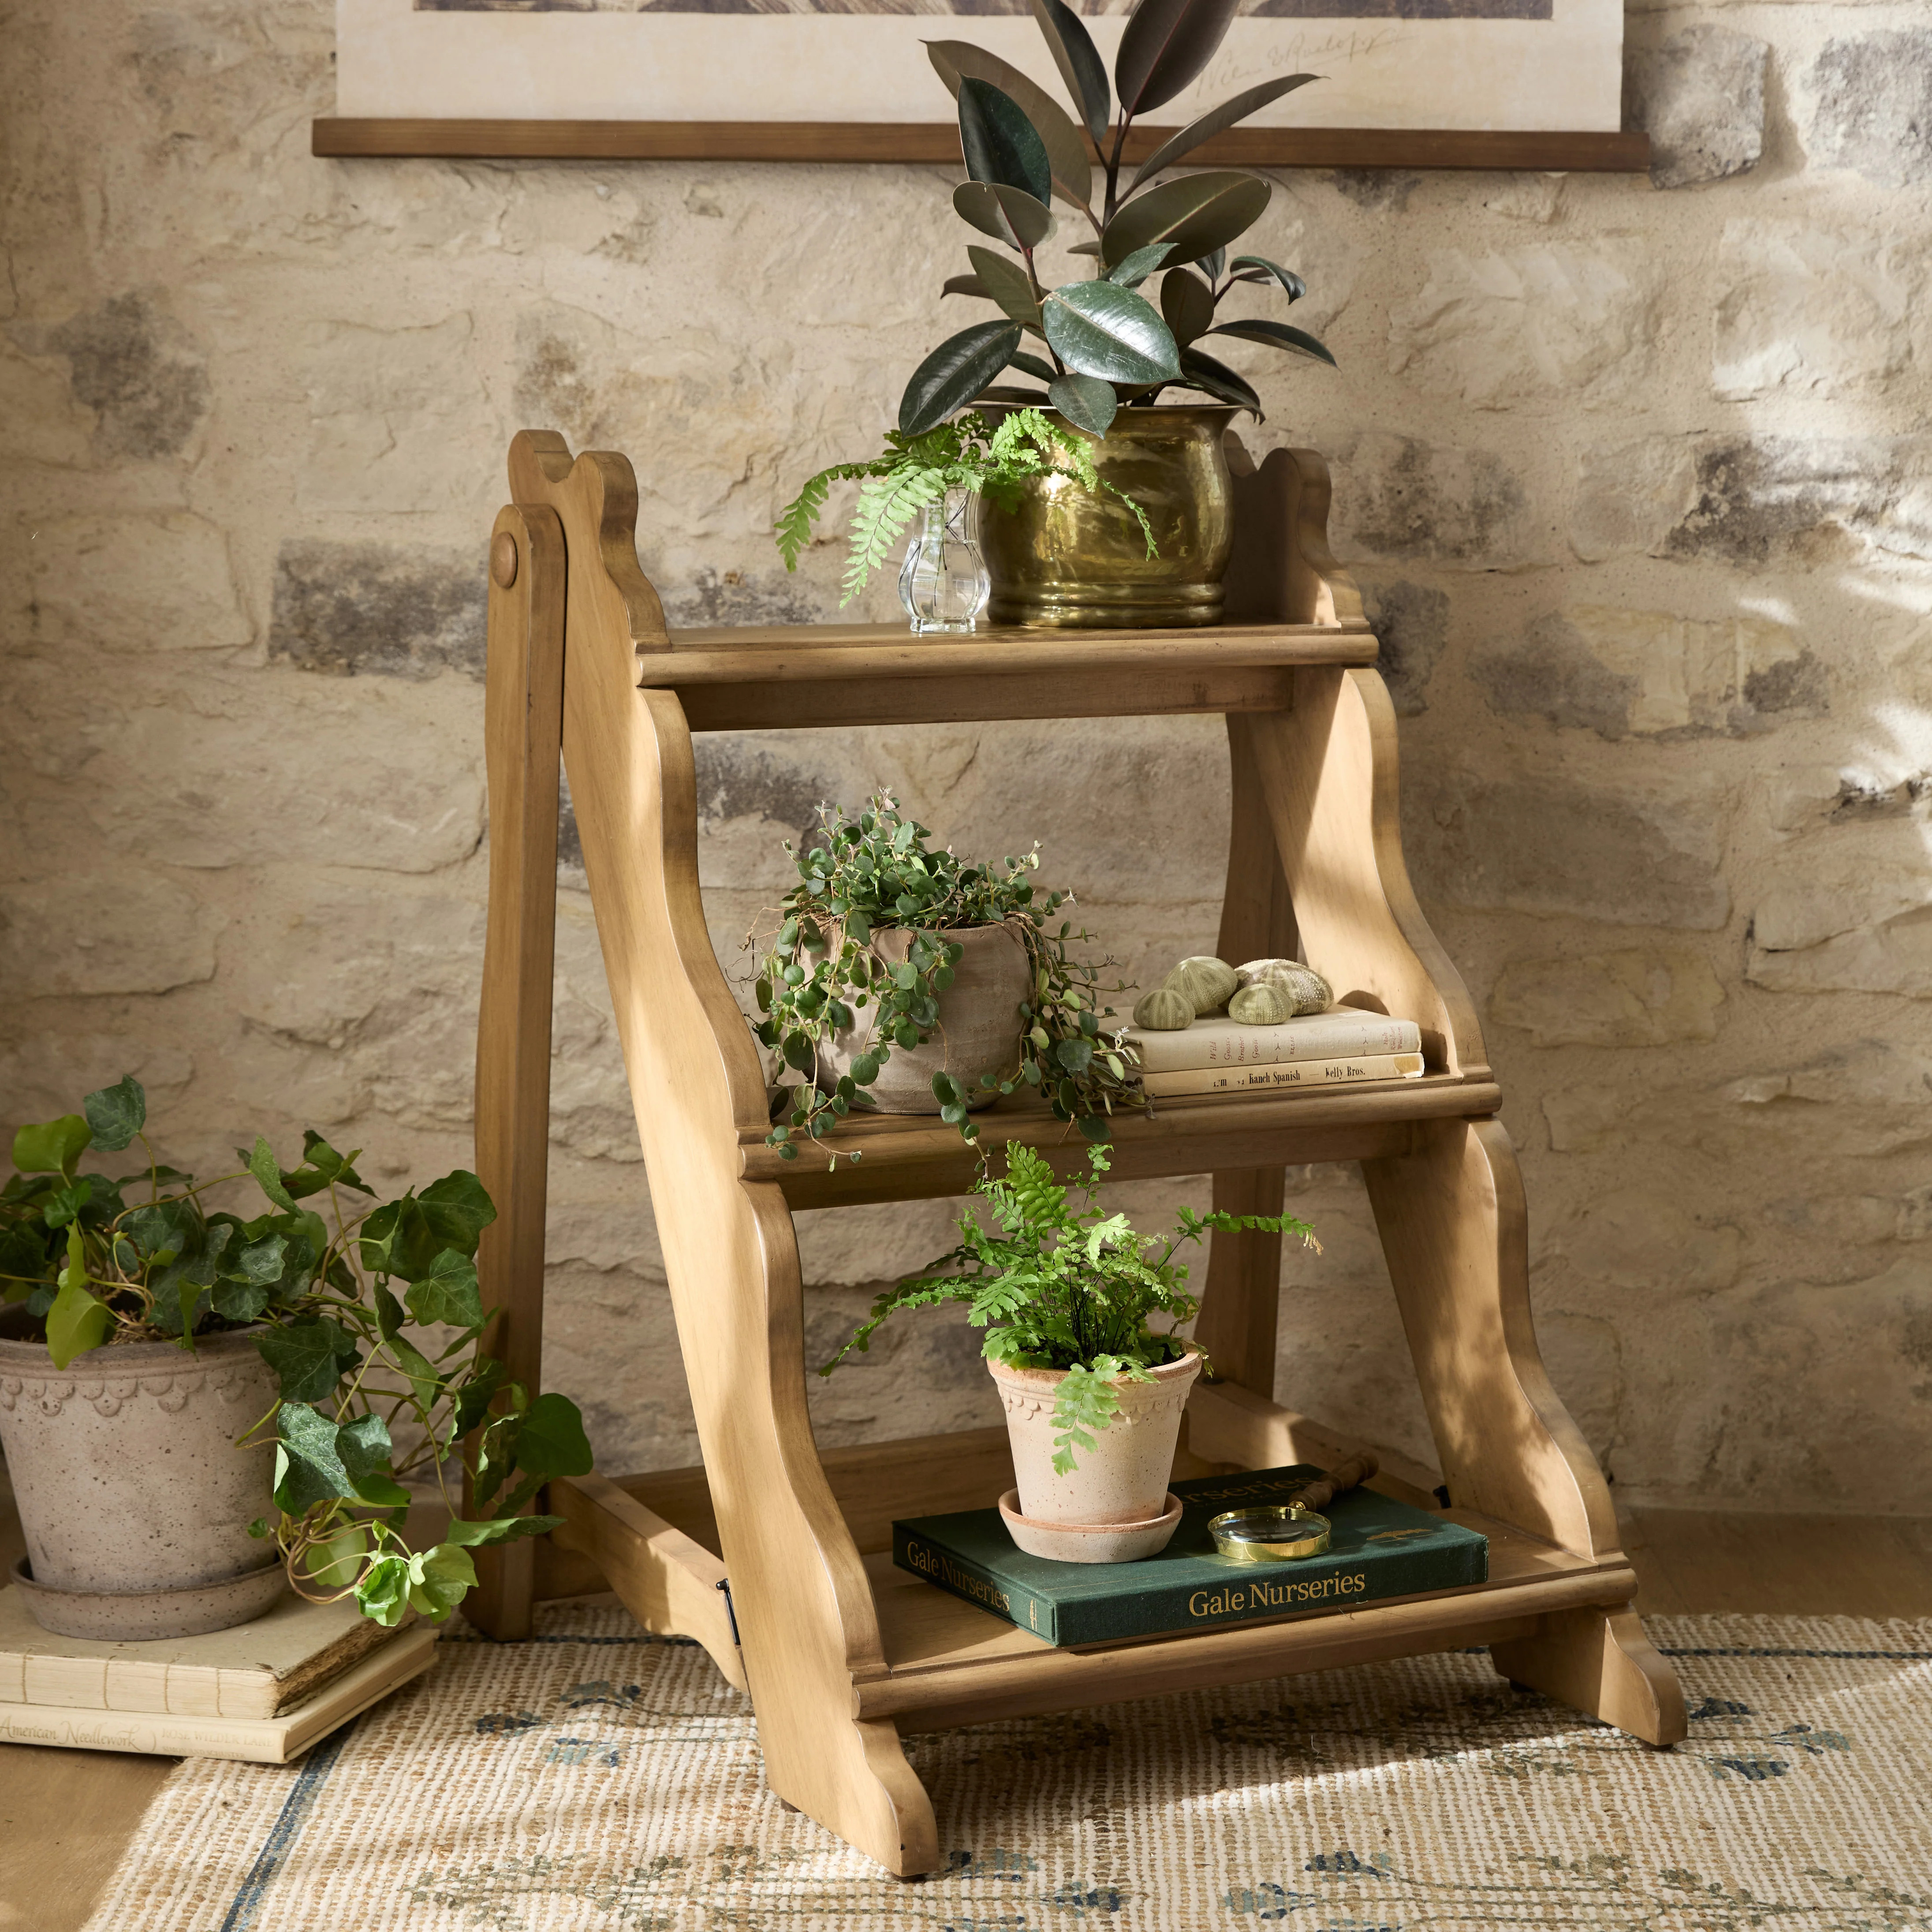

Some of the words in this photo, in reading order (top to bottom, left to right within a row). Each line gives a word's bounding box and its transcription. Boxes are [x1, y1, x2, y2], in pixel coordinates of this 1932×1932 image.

[1249, 1072, 1270, 1084] Ranch
[1273, 1070, 1301, 1084] Spanish
[1325, 1066, 1343, 1080] Kelly
[1347, 1066, 1365, 1076] Bros.
[1183, 1476, 1317, 1503] rseries
[907, 1541, 939, 1577] Gale
[940, 1556, 1010, 1612] Nurseries
[1189, 1588, 1245, 1617] Gale
[1248, 1571, 1365, 1609] Nurseries
[0, 1715, 58, 1739] American
[58, 1720, 142, 1752] Needlework
[162, 1728, 190, 1740] ROSE
[194, 1730, 240, 1745] WILDER
[243, 1734, 274, 1747] LANE
